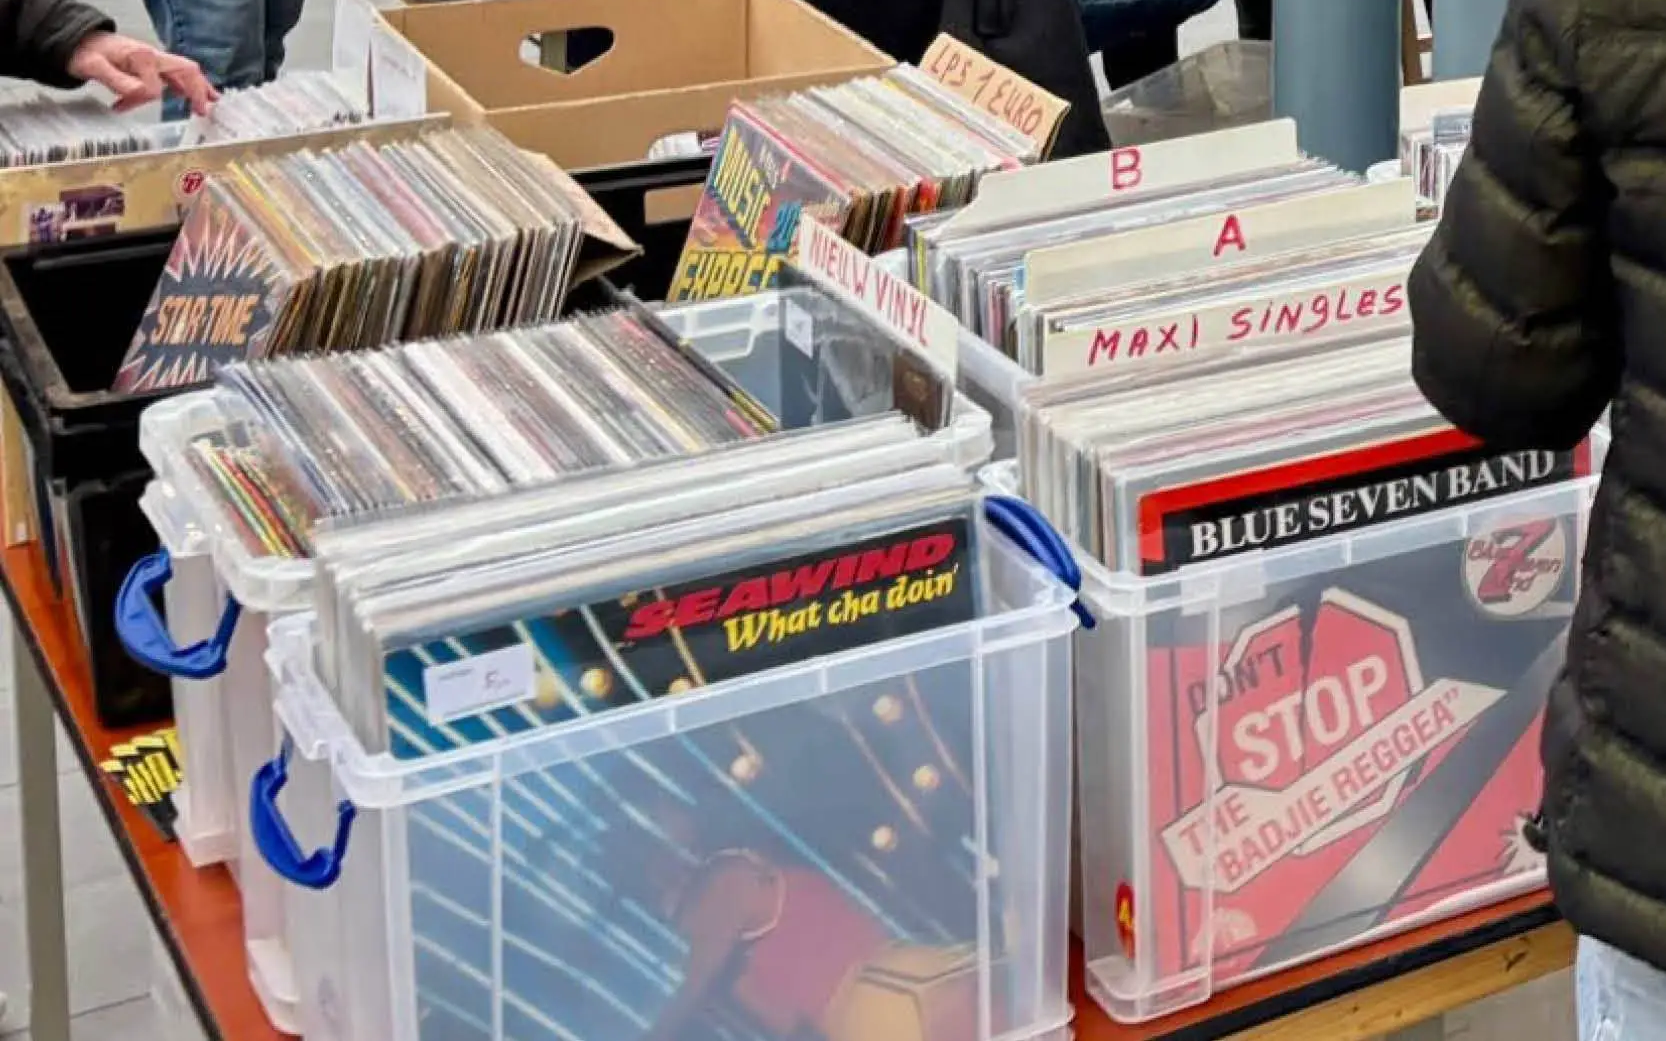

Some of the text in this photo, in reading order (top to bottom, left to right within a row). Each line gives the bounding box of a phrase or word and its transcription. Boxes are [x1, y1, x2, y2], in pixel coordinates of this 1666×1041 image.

[930, 42, 1044, 136] LPS 1 EURO
[1110, 148, 1142, 190] B
[1213, 214, 1247, 257] A
[811, 228, 931, 347] NIEUW VINYL
[1088, 313, 1199, 366] MAXI
[1189, 449, 1556, 559] BLUE SEVEN BAND
[623, 533, 957, 639] SEAWIND
[723, 600, 822, 653] What
[827, 589, 881, 624] cha
[1186, 642, 1284, 716] DON'T
[1231, 654, 1388, 783] STOP
[1178, 791, 1250, 857] THE
[1215, 784, 1332, 884] BADJIE
